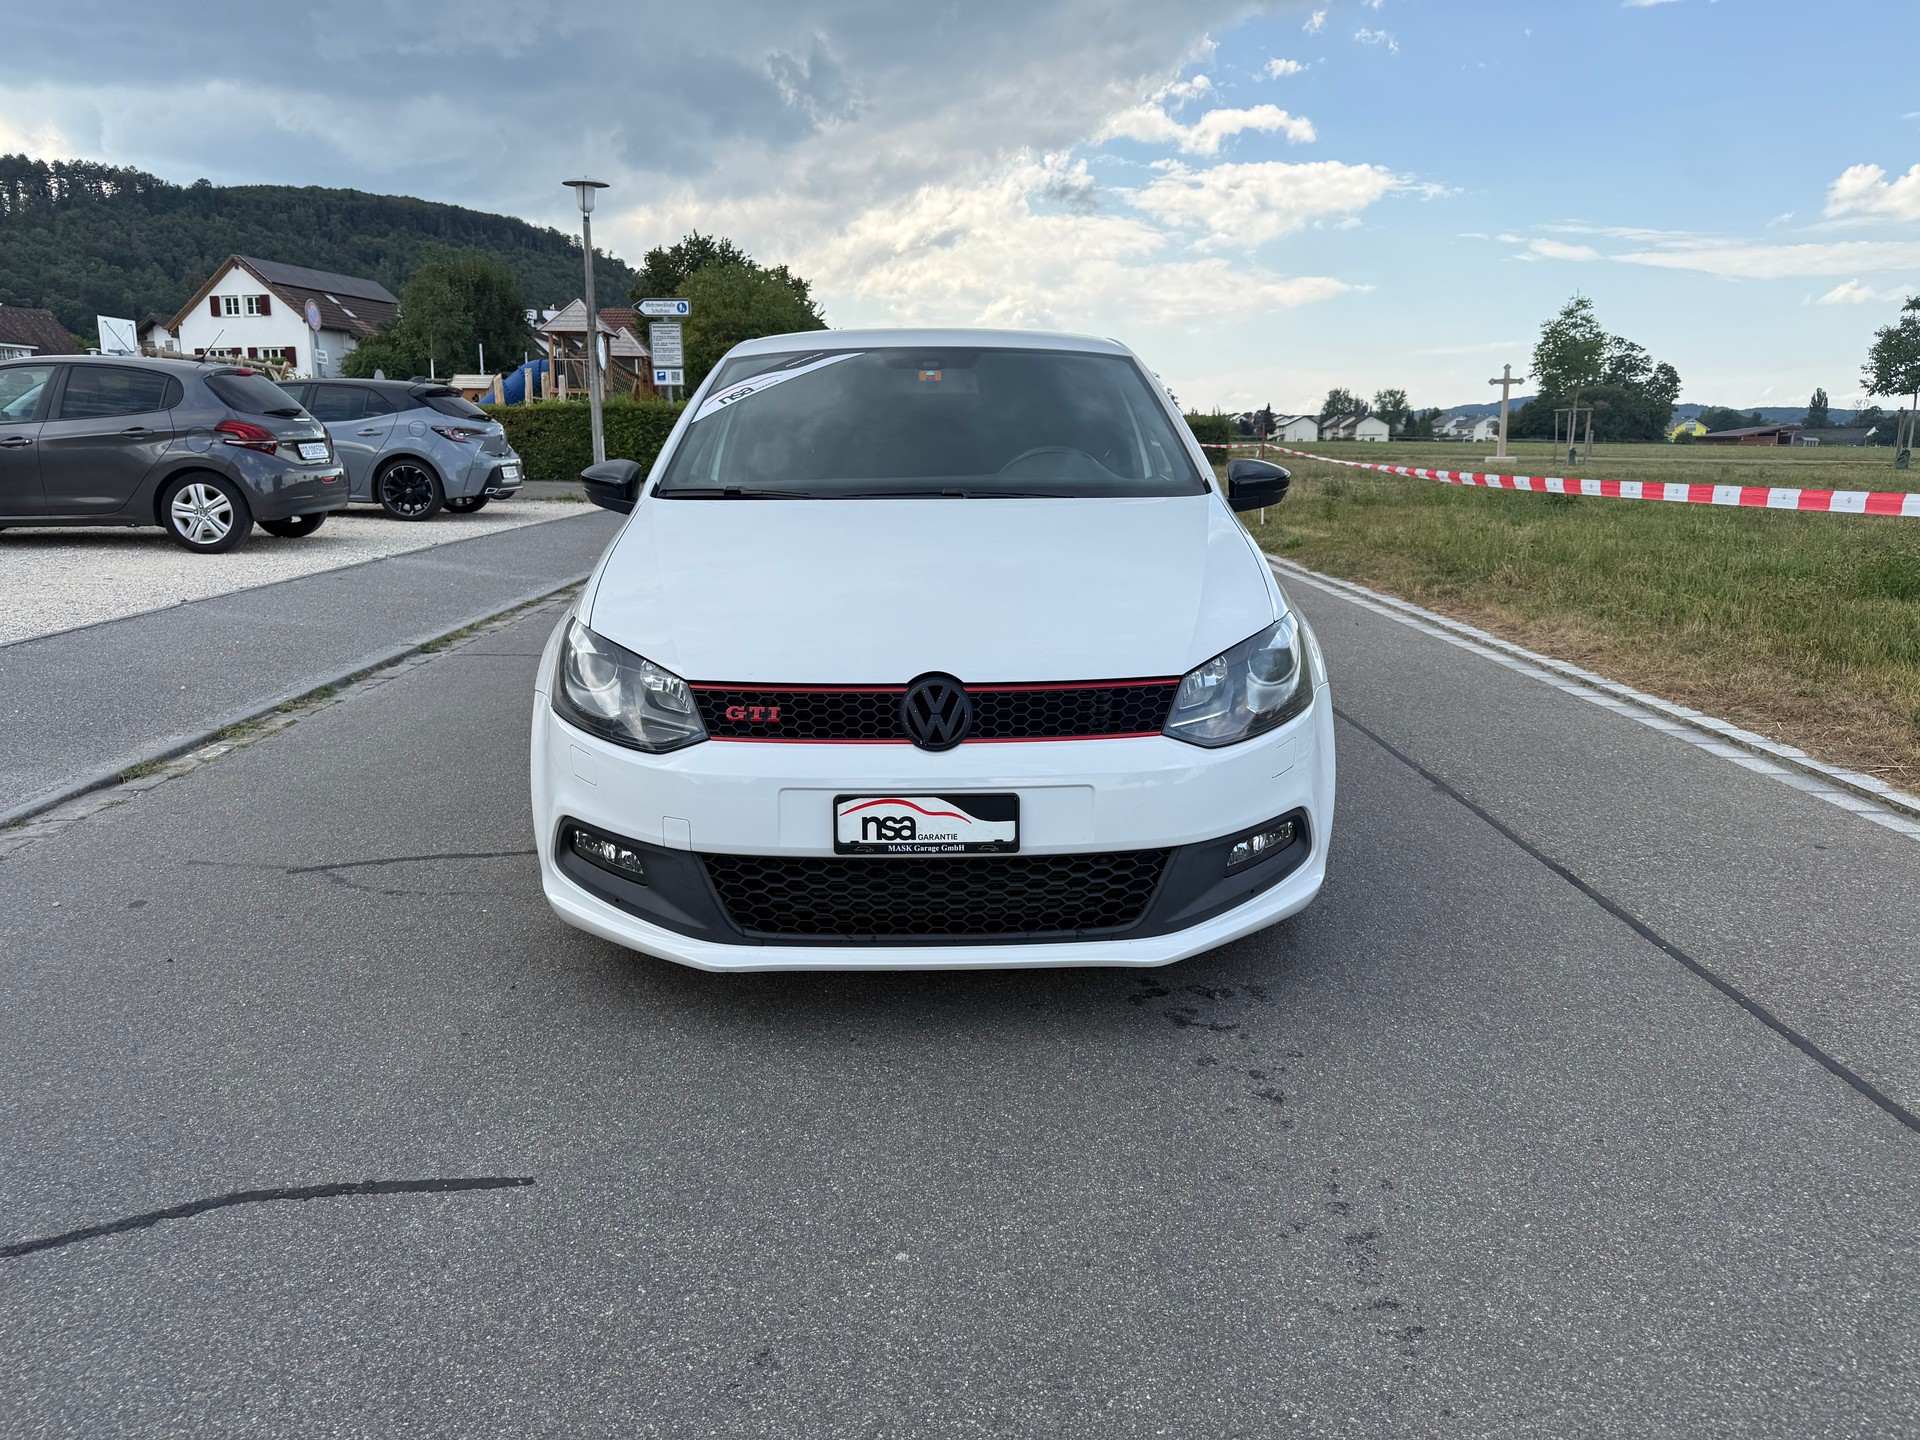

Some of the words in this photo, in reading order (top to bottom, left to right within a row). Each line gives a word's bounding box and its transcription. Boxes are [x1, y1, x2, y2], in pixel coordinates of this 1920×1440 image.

[718, 386, 756, 405] nsa
[725, 705, 781, 722] GTI
[861, 816, 917, 841] nsa
[888, 844, 912, 852] MASK
[913, 844, 940, 853] Garage
[941, 844, 965, 852] GmbH
